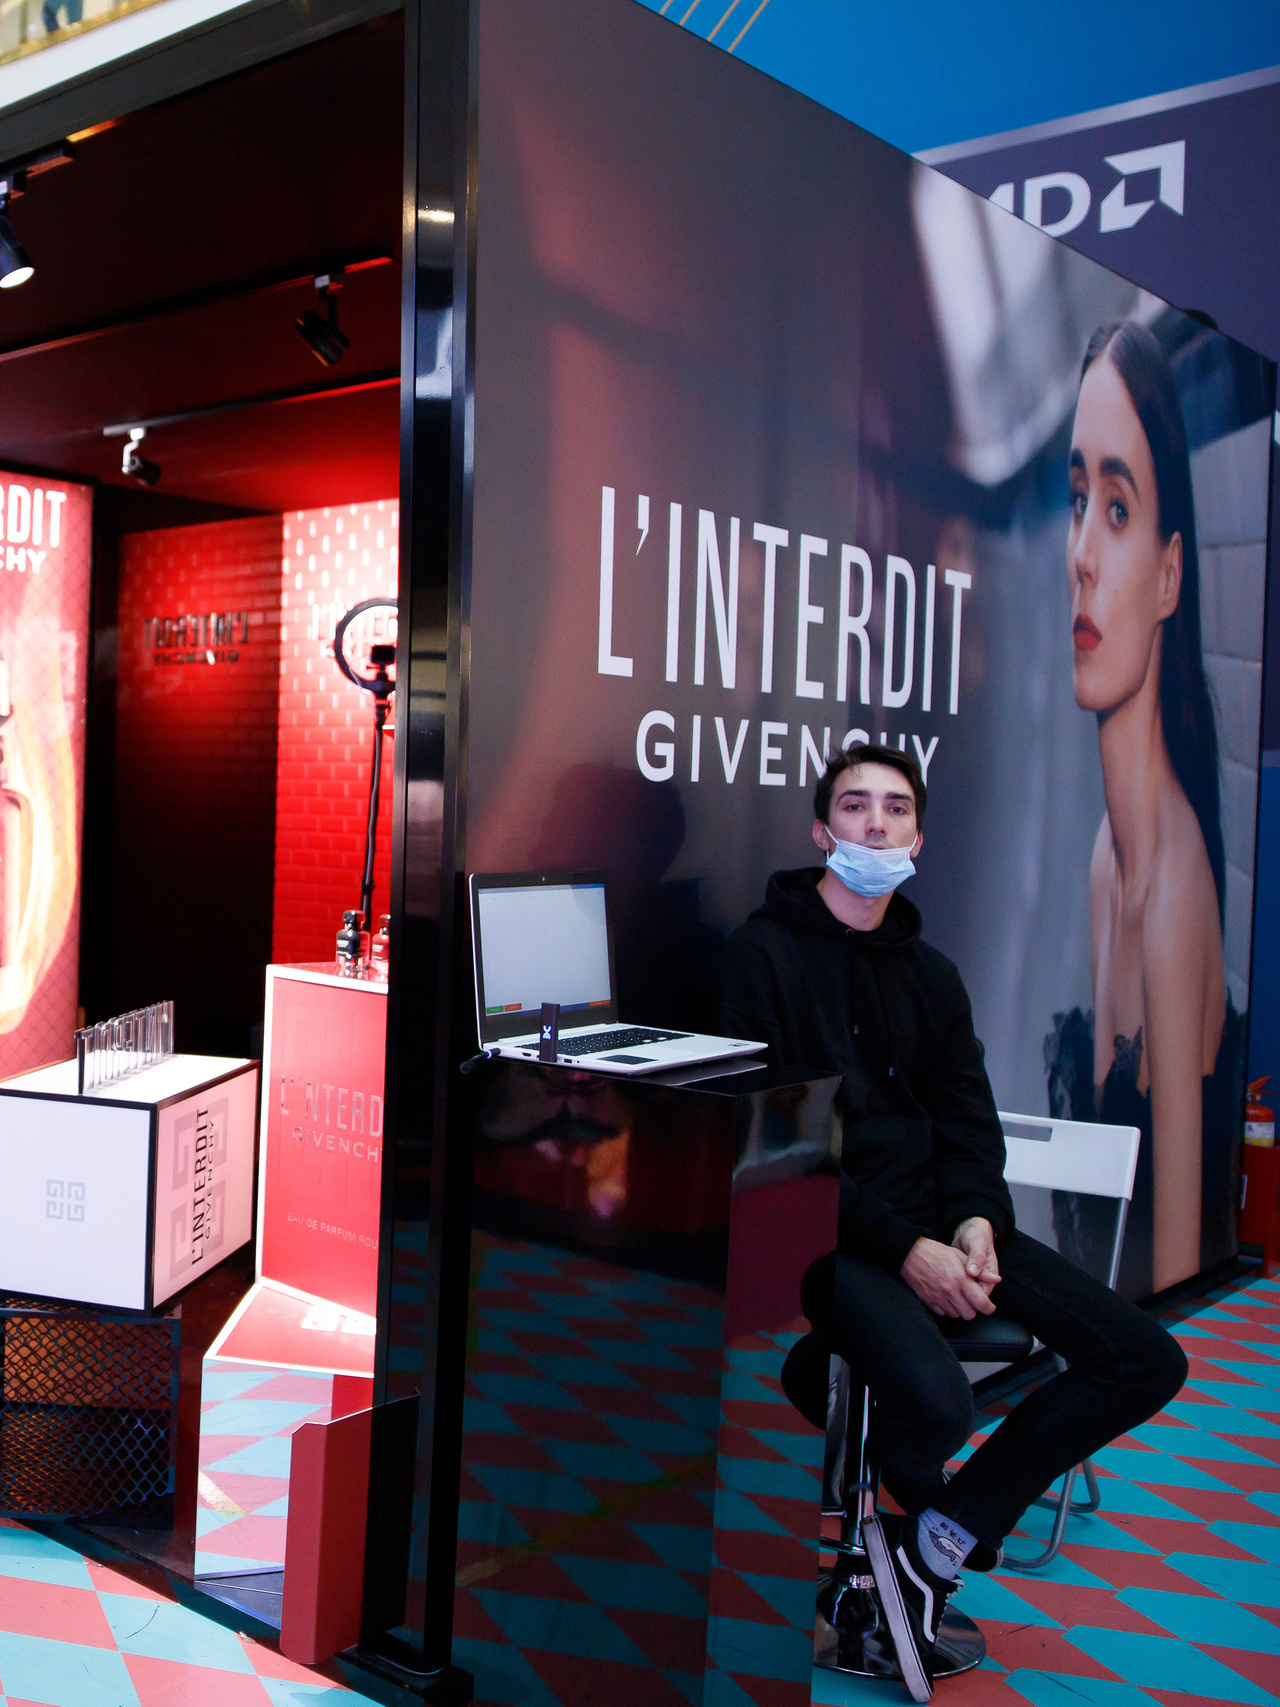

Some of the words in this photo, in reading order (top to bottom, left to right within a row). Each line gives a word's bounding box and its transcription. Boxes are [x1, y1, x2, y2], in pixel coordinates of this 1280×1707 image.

[598, 485, 972, 715] L'INTERDIT
[635, 710, 939, 787] GIVENY
[192, 1109, 209, 1266] L'INTERDIT
[205, 1120, 215, 1239] GIVENCHY
[292, 1127, 382, 1162] GIVENCH
[306, 1218, 318, 1230] DE
[320, 1222, 356, 1242] PARFUM
